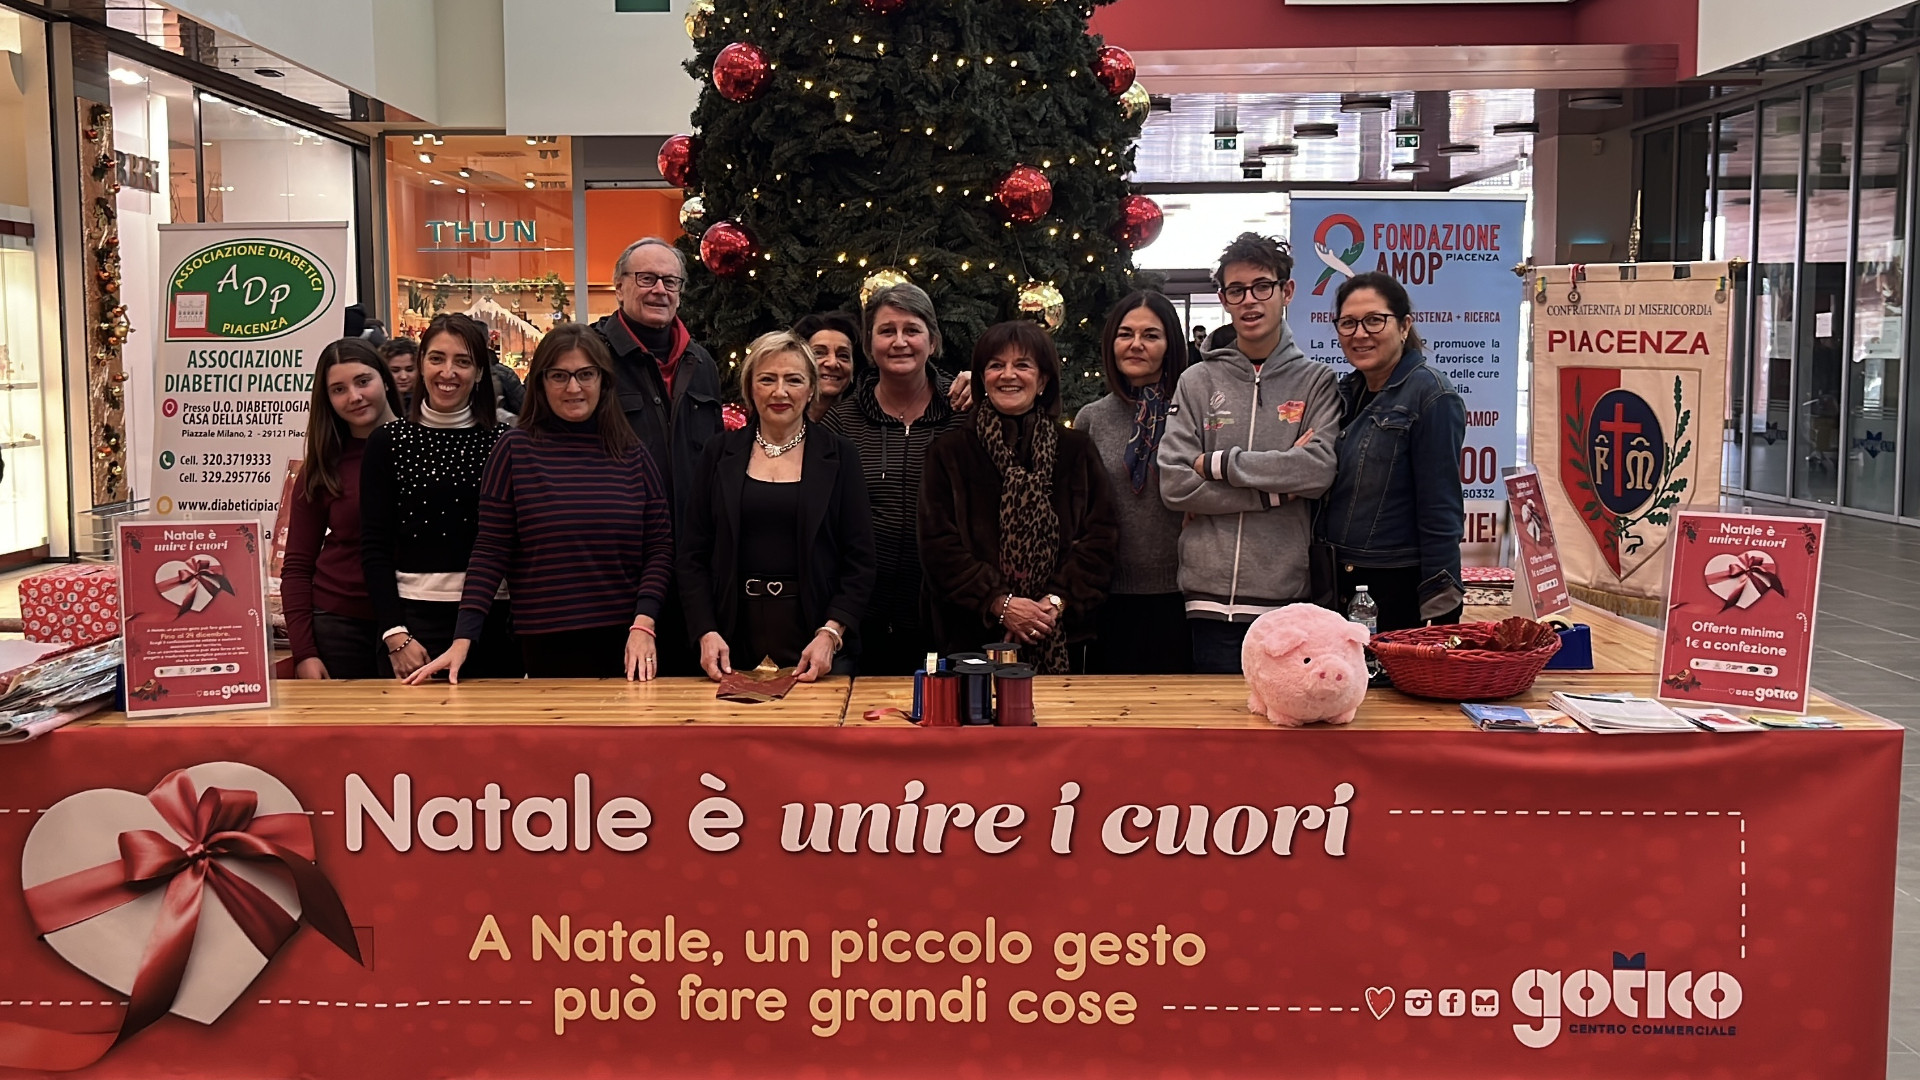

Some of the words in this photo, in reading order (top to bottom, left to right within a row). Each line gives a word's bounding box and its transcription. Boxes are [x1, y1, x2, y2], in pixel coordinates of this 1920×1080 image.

[425, 220, 537, 243] THUN
[1373, 223, 1501, 251] FONDAZIONE
[175, 245, 266, 289] ASSOCIAZIONE
[269, 247, 323, 292] DIABETICI
[1376, 251, 1444, 285] AMOP
[1445, 253, 1500, 262] PIACENZA
[1411, 312, 1453, 323] SISTENZA
[1464, 312, 1501, 323] RICERCA
[1547, 304, 1621, 316] CONFRATERNITA
[1624, 304, 1636, 316] DI
[1638, 304, 1713, 316] MISERICORDIA
[222, 316, 289, 335] PIACENZA
[1310, 339, 1324, 349] La
[1433, 340, 1486, 350] promuove
[1491, 339, 1500, 348] la
[1548, 329, 1710, 356] PIACENZA
[187, 350, 303, 369] ASSOCIAZIONE
[1435, 353, 1484, 363] favorisce
[1491, 354, 1500, 363] la
[1450, 369, 1475, 378] delle
[1477, 371, 1500, 379] cure
[165, 374, 243, 393] DIABETICI
[247, 373, 315, 392] PIACENZ
[183, 403, 211, 412] Presso
[213, 401, 234, 412] U.O.
[236, 400, 310, 412] DIABETOLOGIA
[182, 413, 209, 425] CASA
[212, 413, 243, 425] DELLA
[246, 413, 283, 425] SALUTE
[1465, 411, 1499, 427] AMOP
[182, 430, 215, 438] Piazzale
[216, 430, 246, 439] Milano,
[247, 430, 253, 438] 2
[262, 430, 286, 438] 29121
[288, 430, 307, 438] Piac
[180, 455, 199, 466] Cell.
[202, 453, 272, 466] 320.3719333
[179, 472, 198, 483] Cell.
[201, 471, 271, 483] 329.2957766
[1463, 489, 1495, 499] 60332
[164, 530, 205, 541] Natale
[208, 529, 217, 539] è
[1720, 522, 1763, 536] Natale
[1766, 525, 1776, 537] è
[154, 541, 187, 552] unire
[195, 540, 228, 550] cuori
[1708, 534, 1742, 546] unire
[1744, 535, 1750, 546] i
[1751, 538, 1787, 549] cuori
[1691, 621, 1737, 635] Offerta
[1740, 627, 1785, 640] minima
[1685, 636, 1700, 649] 1€
[1703, 641, 1712, 649] a
[1713, 640, 1788, 657] confezione
[344, 772, 653, 853] Natale
[687, 772, 745, 853] è
[780, 779, 1026, 855] unire
[1050, 781, 1082, 856] i
[1101, 782, 1356, 858] cuori
[468, 914, 512, 962] A
[531, 914, 725, 967] Natale,
[744, 929, 810, 963] un
[831, 916, 1033, 979] piccolo
[1053, 924, 1207, 982] gesto
[554, 973, 657, 1036] può
[677, 973, 789, 1022] fare
[808, 974, 988, 1038] grandi
[1008, 989, 1138, 1025] cose
[1511, 952, 1744, 1050] gotico
[1569, 1023, 1627, 1036] CENTRO
[1632, 1023, 1737, 1037] COMMERCIALE
